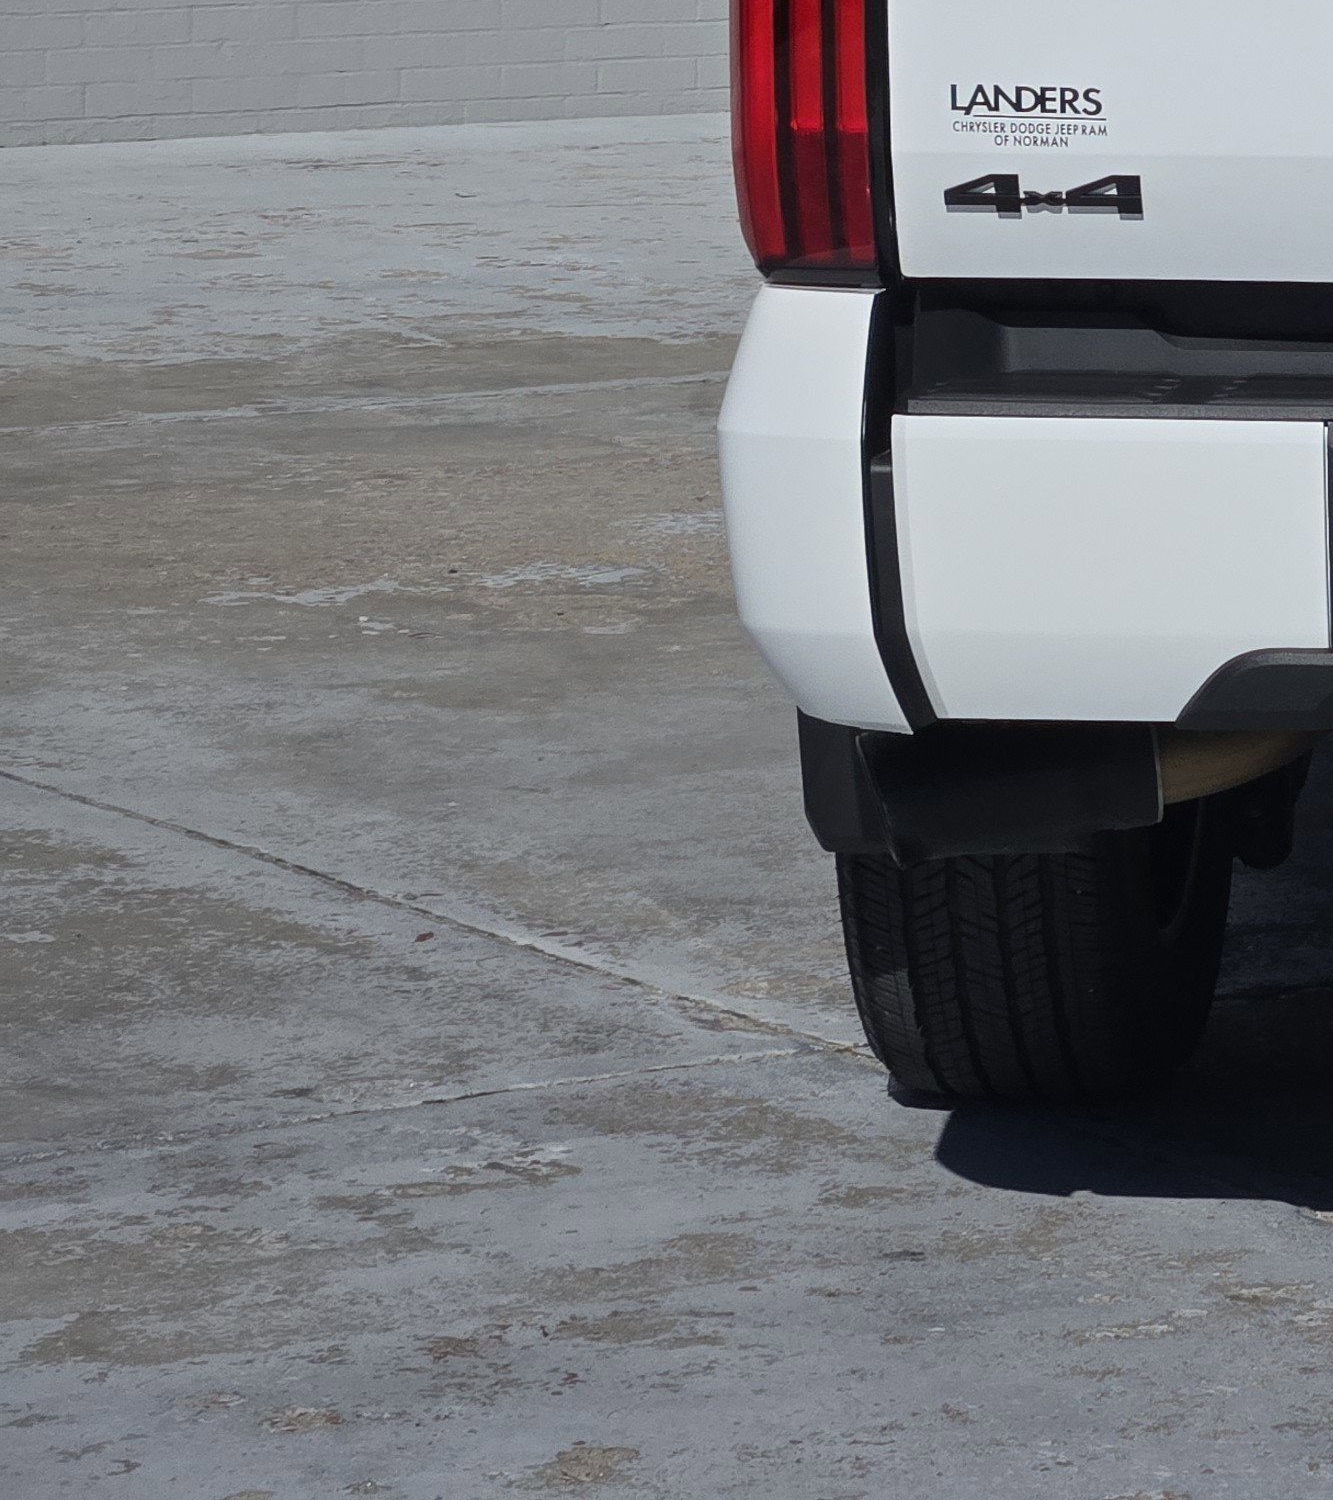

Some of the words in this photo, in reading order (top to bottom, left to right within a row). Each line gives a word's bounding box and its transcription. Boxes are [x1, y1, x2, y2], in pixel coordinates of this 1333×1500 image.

[950, 84, 1103, 115] LANDERS
[952, 121, 1006, 133] CHRYSLER
[1010, 122, 1051, 135] DODGE
[1055, 124, 1078, 135] JEEP
[1081, 125, 1108, 136] RAM
[994, 135, 1010, 147] OF
[1013, 136, 1069, 147] NORMAN
